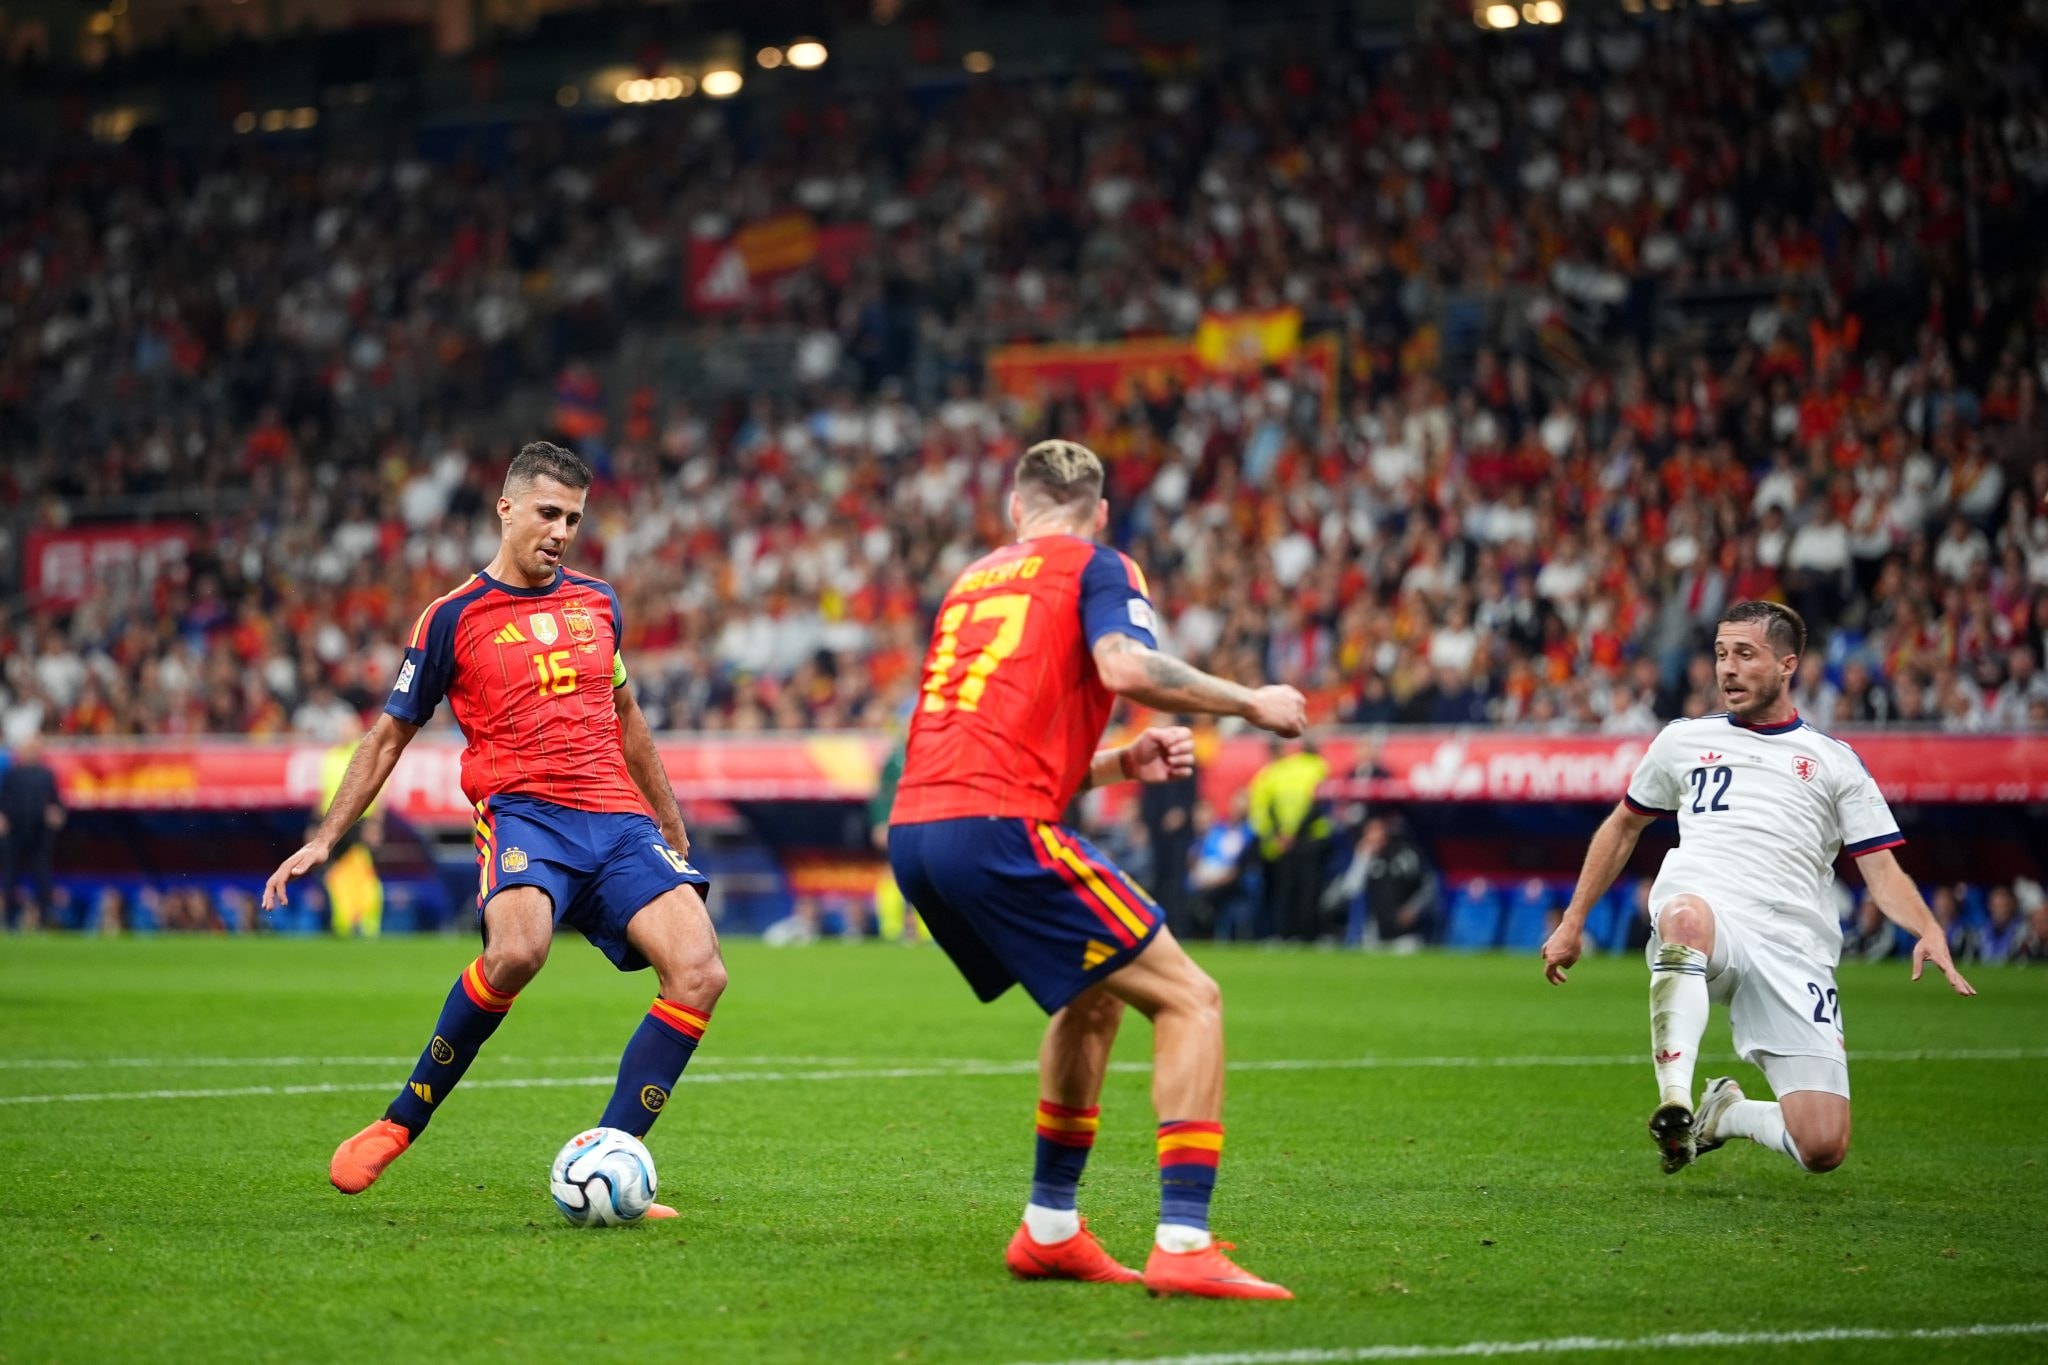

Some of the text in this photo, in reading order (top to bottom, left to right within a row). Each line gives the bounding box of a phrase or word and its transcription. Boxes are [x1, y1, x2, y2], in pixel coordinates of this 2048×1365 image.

[533, 650, 577, 697] 16
[923, 594, 1031, 712] 17
[1691, 766, 1732, 814] 22
[1807, 982, 1844, 1034] 22
